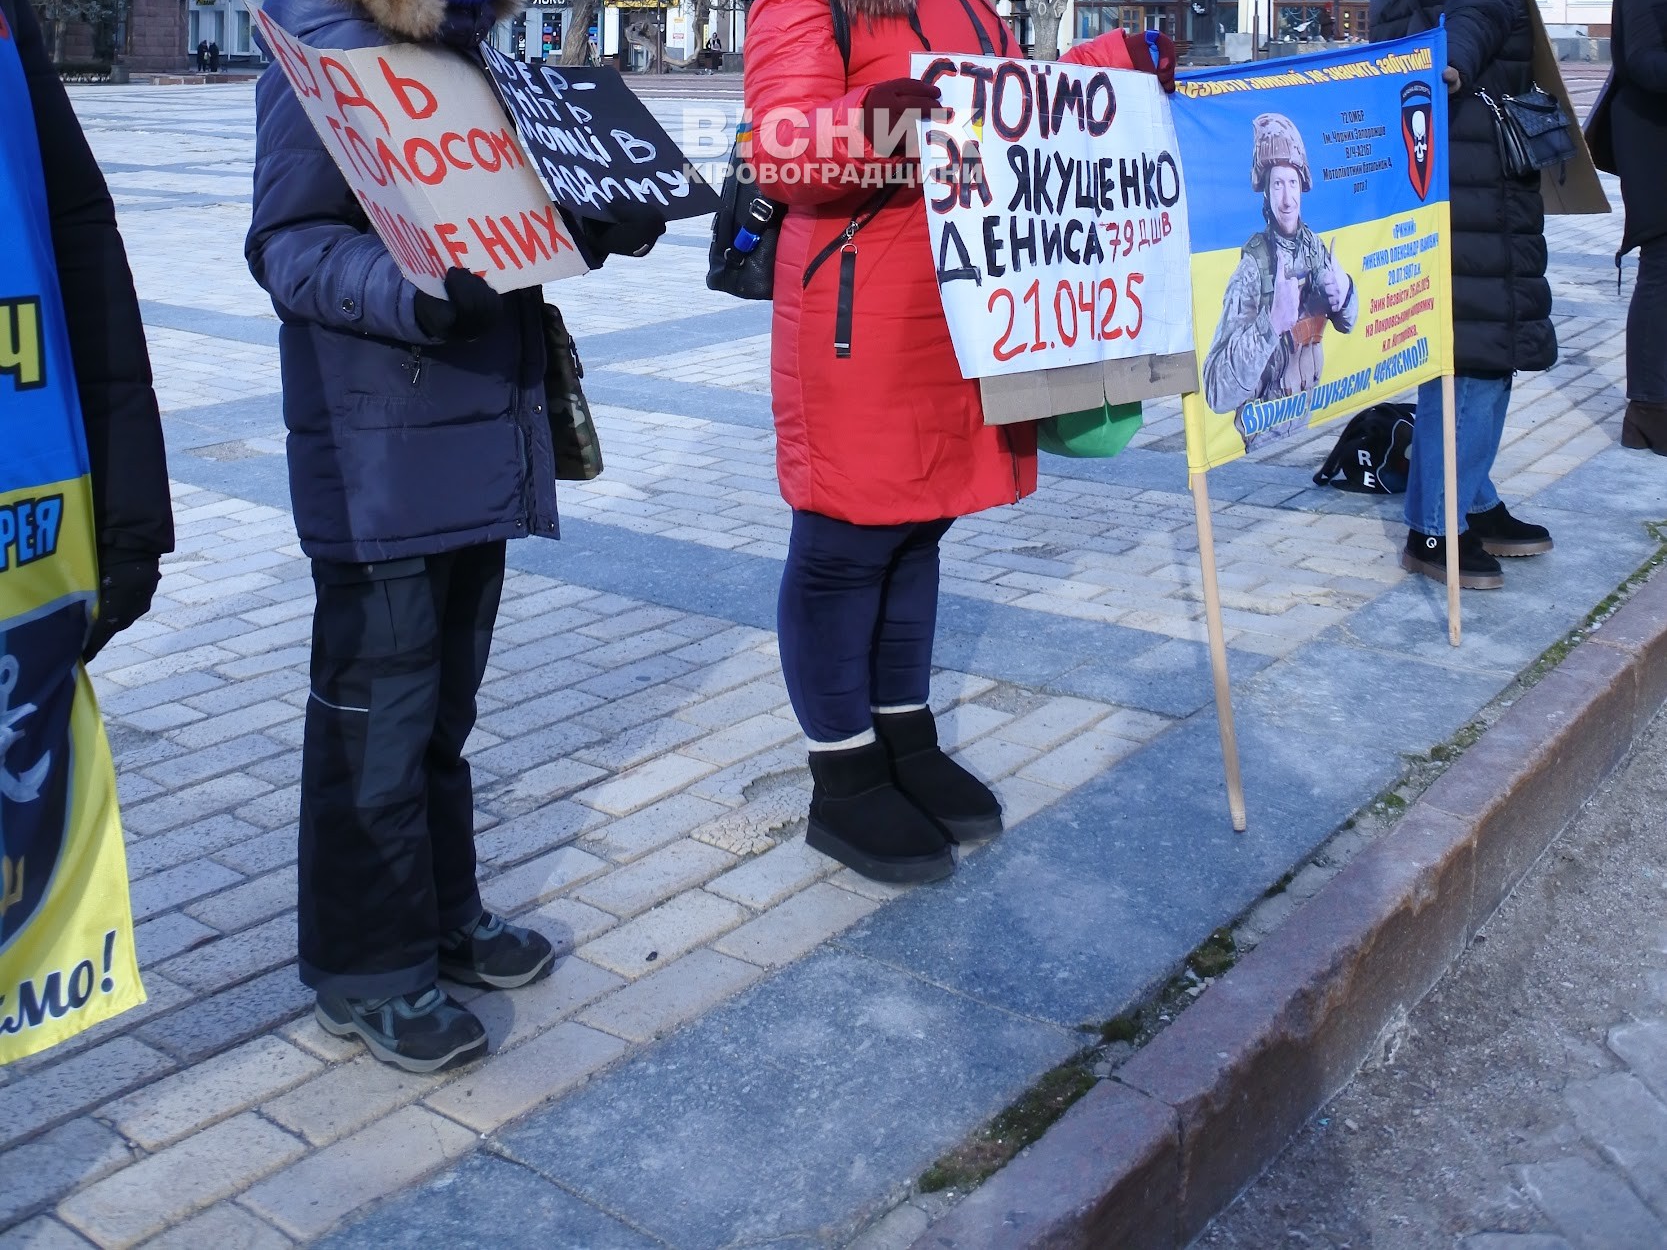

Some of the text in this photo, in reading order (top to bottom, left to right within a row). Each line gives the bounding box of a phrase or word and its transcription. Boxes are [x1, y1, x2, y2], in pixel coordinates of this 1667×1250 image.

[258, 9, 438, 137] БУДЬ
[921, 58, 1117, 142] СТОЇМО
[1323, 60, 1381, 81] значить
[1376, 48, 1433, 74] забутий!!!
[326, 115, 525, 186] ГОЛОСОМ
[926, 130, 1181, 218] ЗА ЯКУЩЕНКО
[357, 189, 574, 279] ПОЛОНЕНИХ
[937, 212, 1173, 289] ДЕНИСА 79 ДШВ
[1241, 337, 1430, 436] Віримо, шукаємо, чекаємо!!!
[0, 930, 116, 1034] мо!
